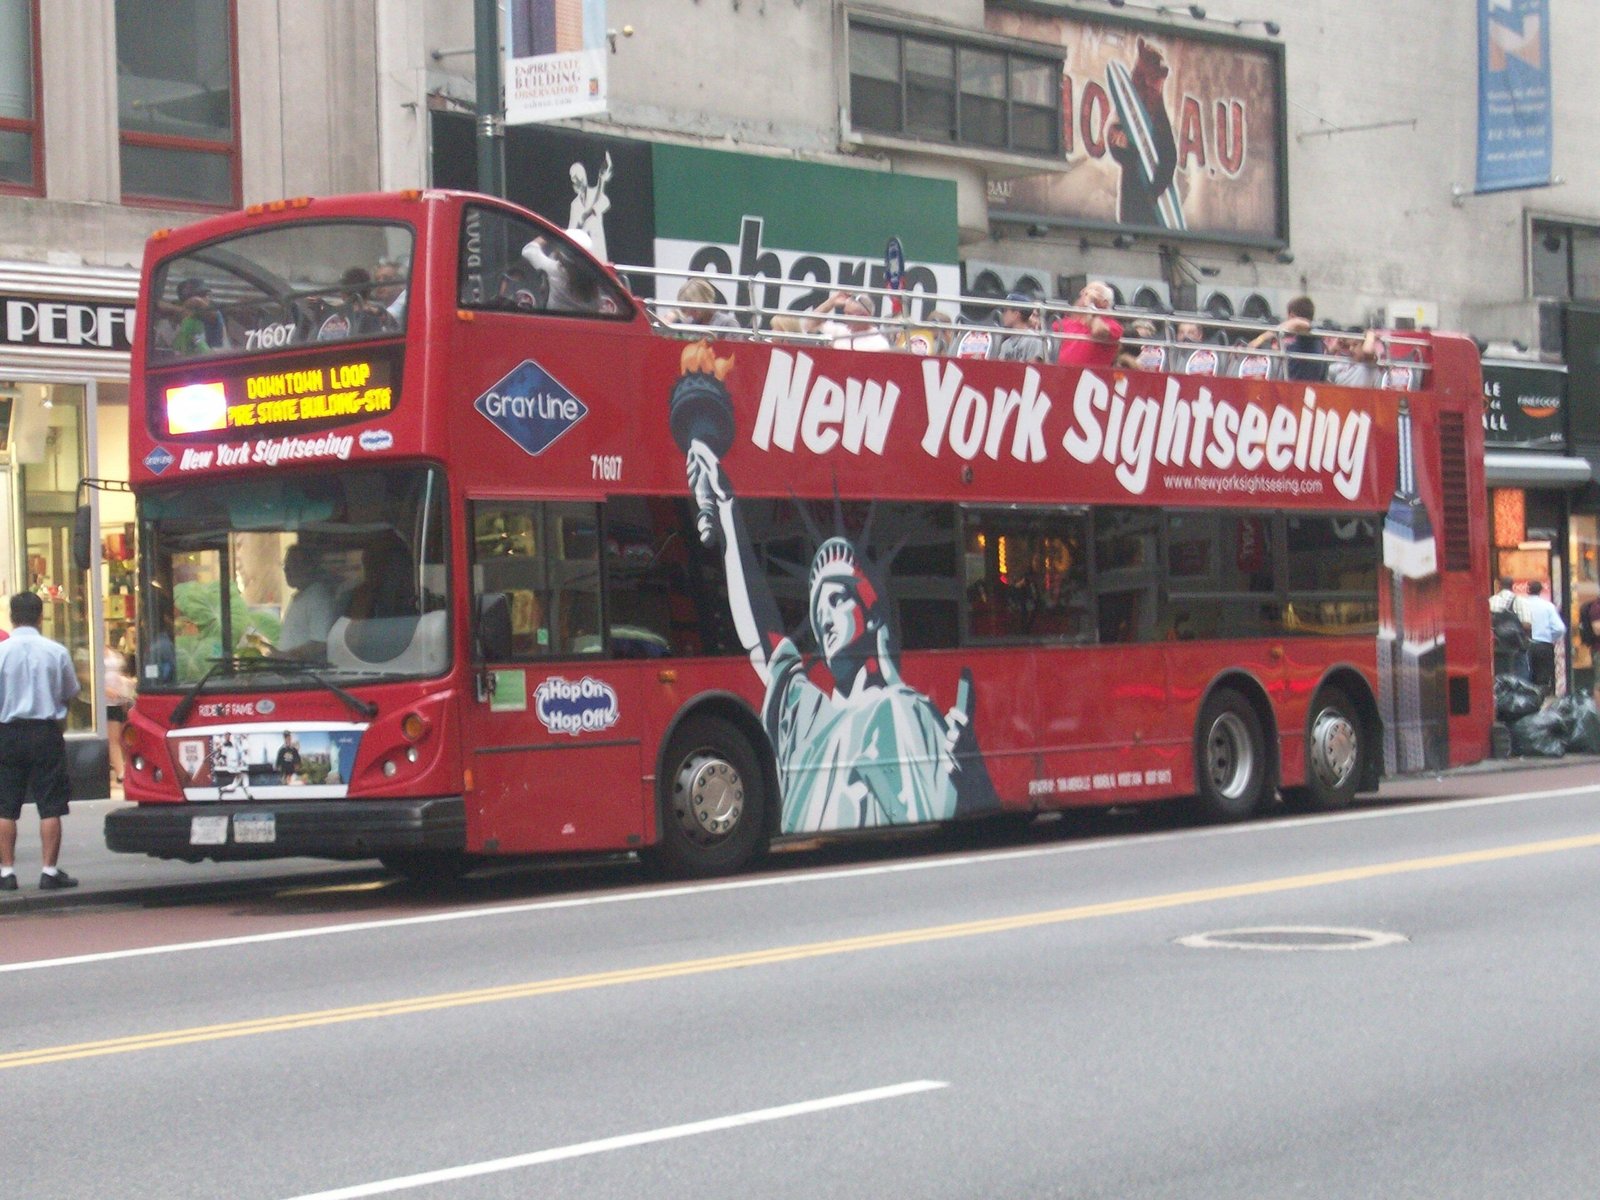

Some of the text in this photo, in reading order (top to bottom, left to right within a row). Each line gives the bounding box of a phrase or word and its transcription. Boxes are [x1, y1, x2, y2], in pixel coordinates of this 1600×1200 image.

[551, 60, 578, 72] STATE
[515, 71, 580, 89] BUILDING
[515, 86, 579, 99] OBSERVATORY
[245, 323, 296, 350] 71607
[247, 363, 370, 400] DOWNTOWN LOOP
[256, 398, 300, 425] STATE
[751, 347, 1371, 501] New York Sightseeing
[179, 448, 213, 471] New
[216, 441, 250, 467] York
[252, 432, 354, 466] Sightseeing
[590, 454, 623, 481] 71607
[1163, 474, 1323, 497] www.newyorksightseeing.com
[549, 679, 605, 703] Hop On
[549, 707, 606, 732] Hop Off
